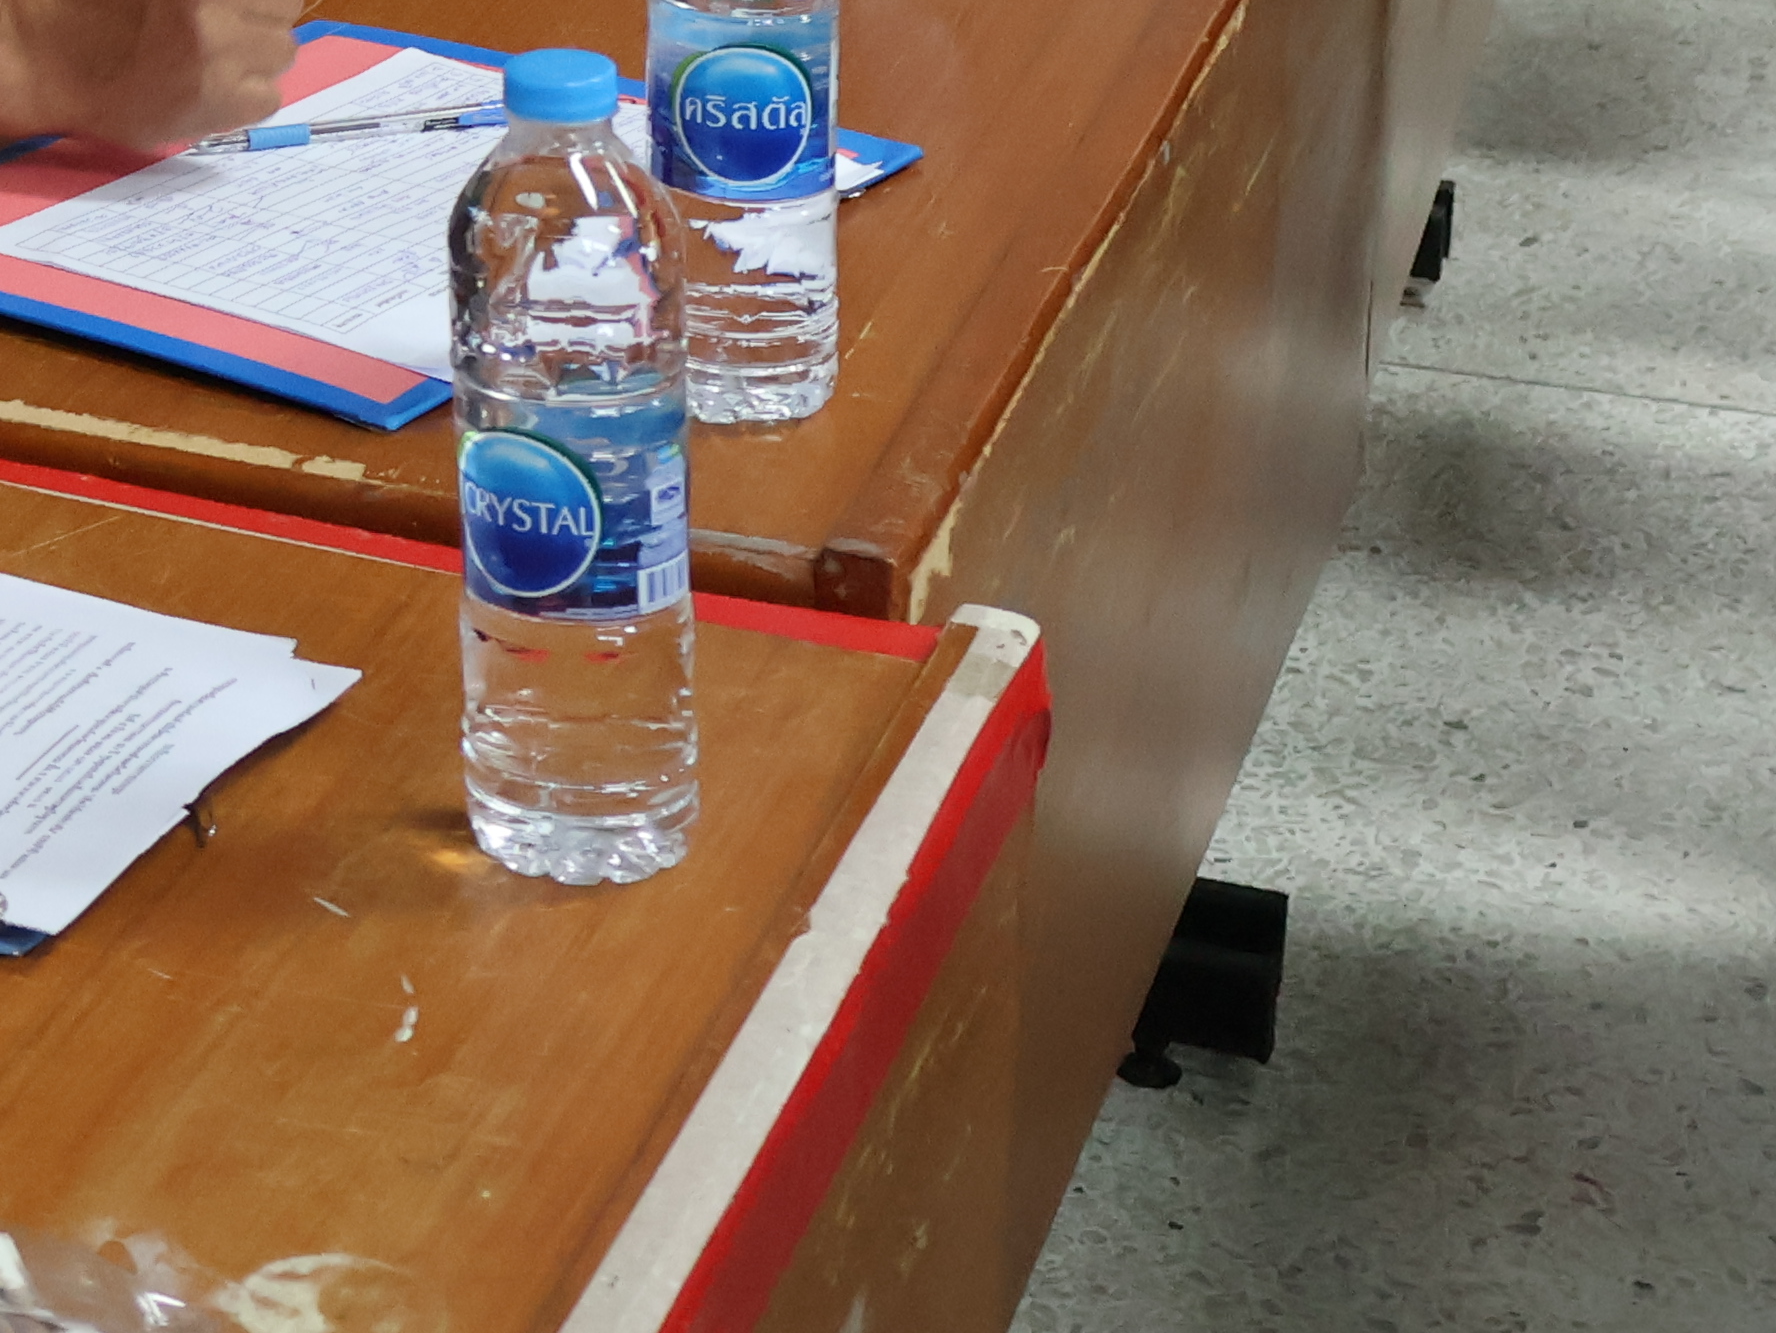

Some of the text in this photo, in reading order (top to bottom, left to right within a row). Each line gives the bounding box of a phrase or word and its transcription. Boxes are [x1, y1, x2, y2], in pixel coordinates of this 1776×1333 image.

[683, 92, 808, 132] คริสตัล
[464, 481, 597, 537] CRYSTAL
